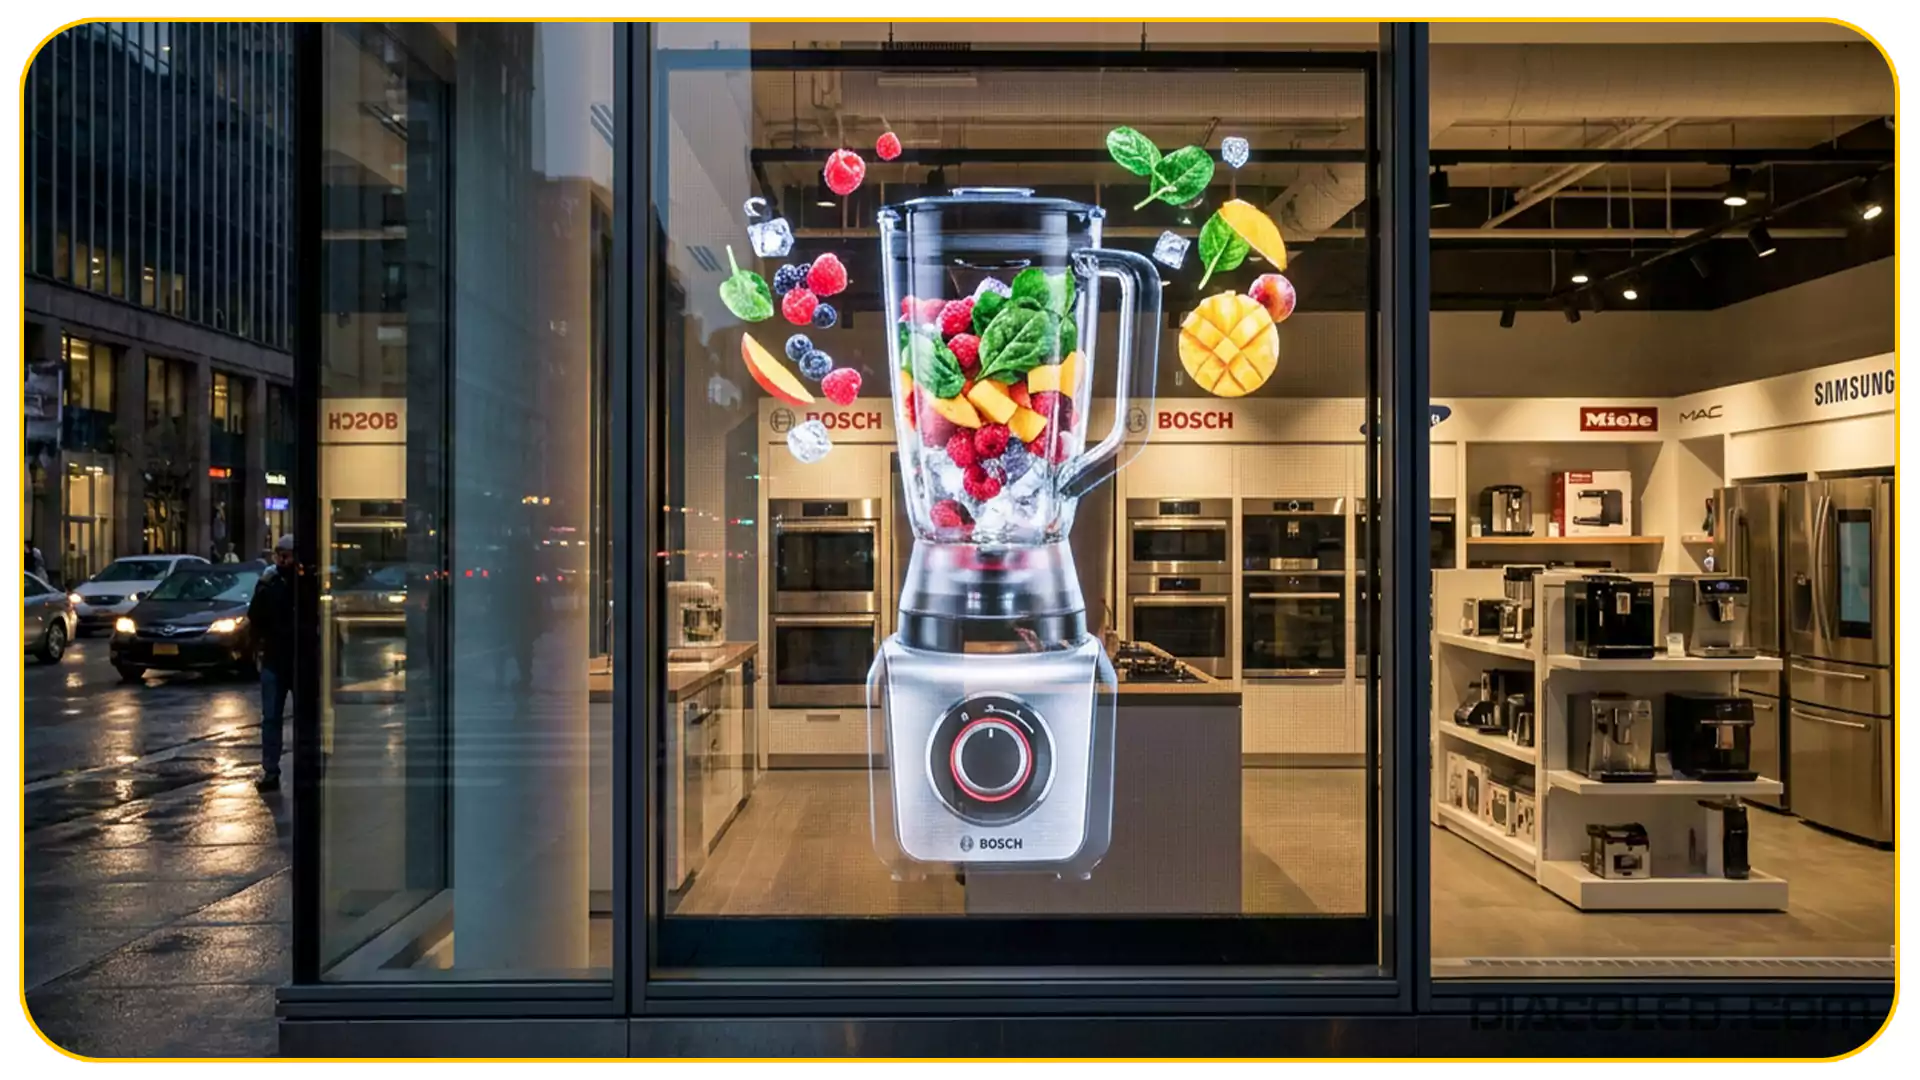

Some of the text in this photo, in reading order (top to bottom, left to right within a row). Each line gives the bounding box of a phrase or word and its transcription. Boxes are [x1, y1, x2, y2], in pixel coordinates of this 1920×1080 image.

[1815, 369, 1895, 406] SAMSUNG
[1158, 412, 1233, 429] BOSCH
[1585, 412, 1653, 427] Miele
[1679, 405, 1723, 424] MAC
[980, 838, 1022, 850] BOSCH
